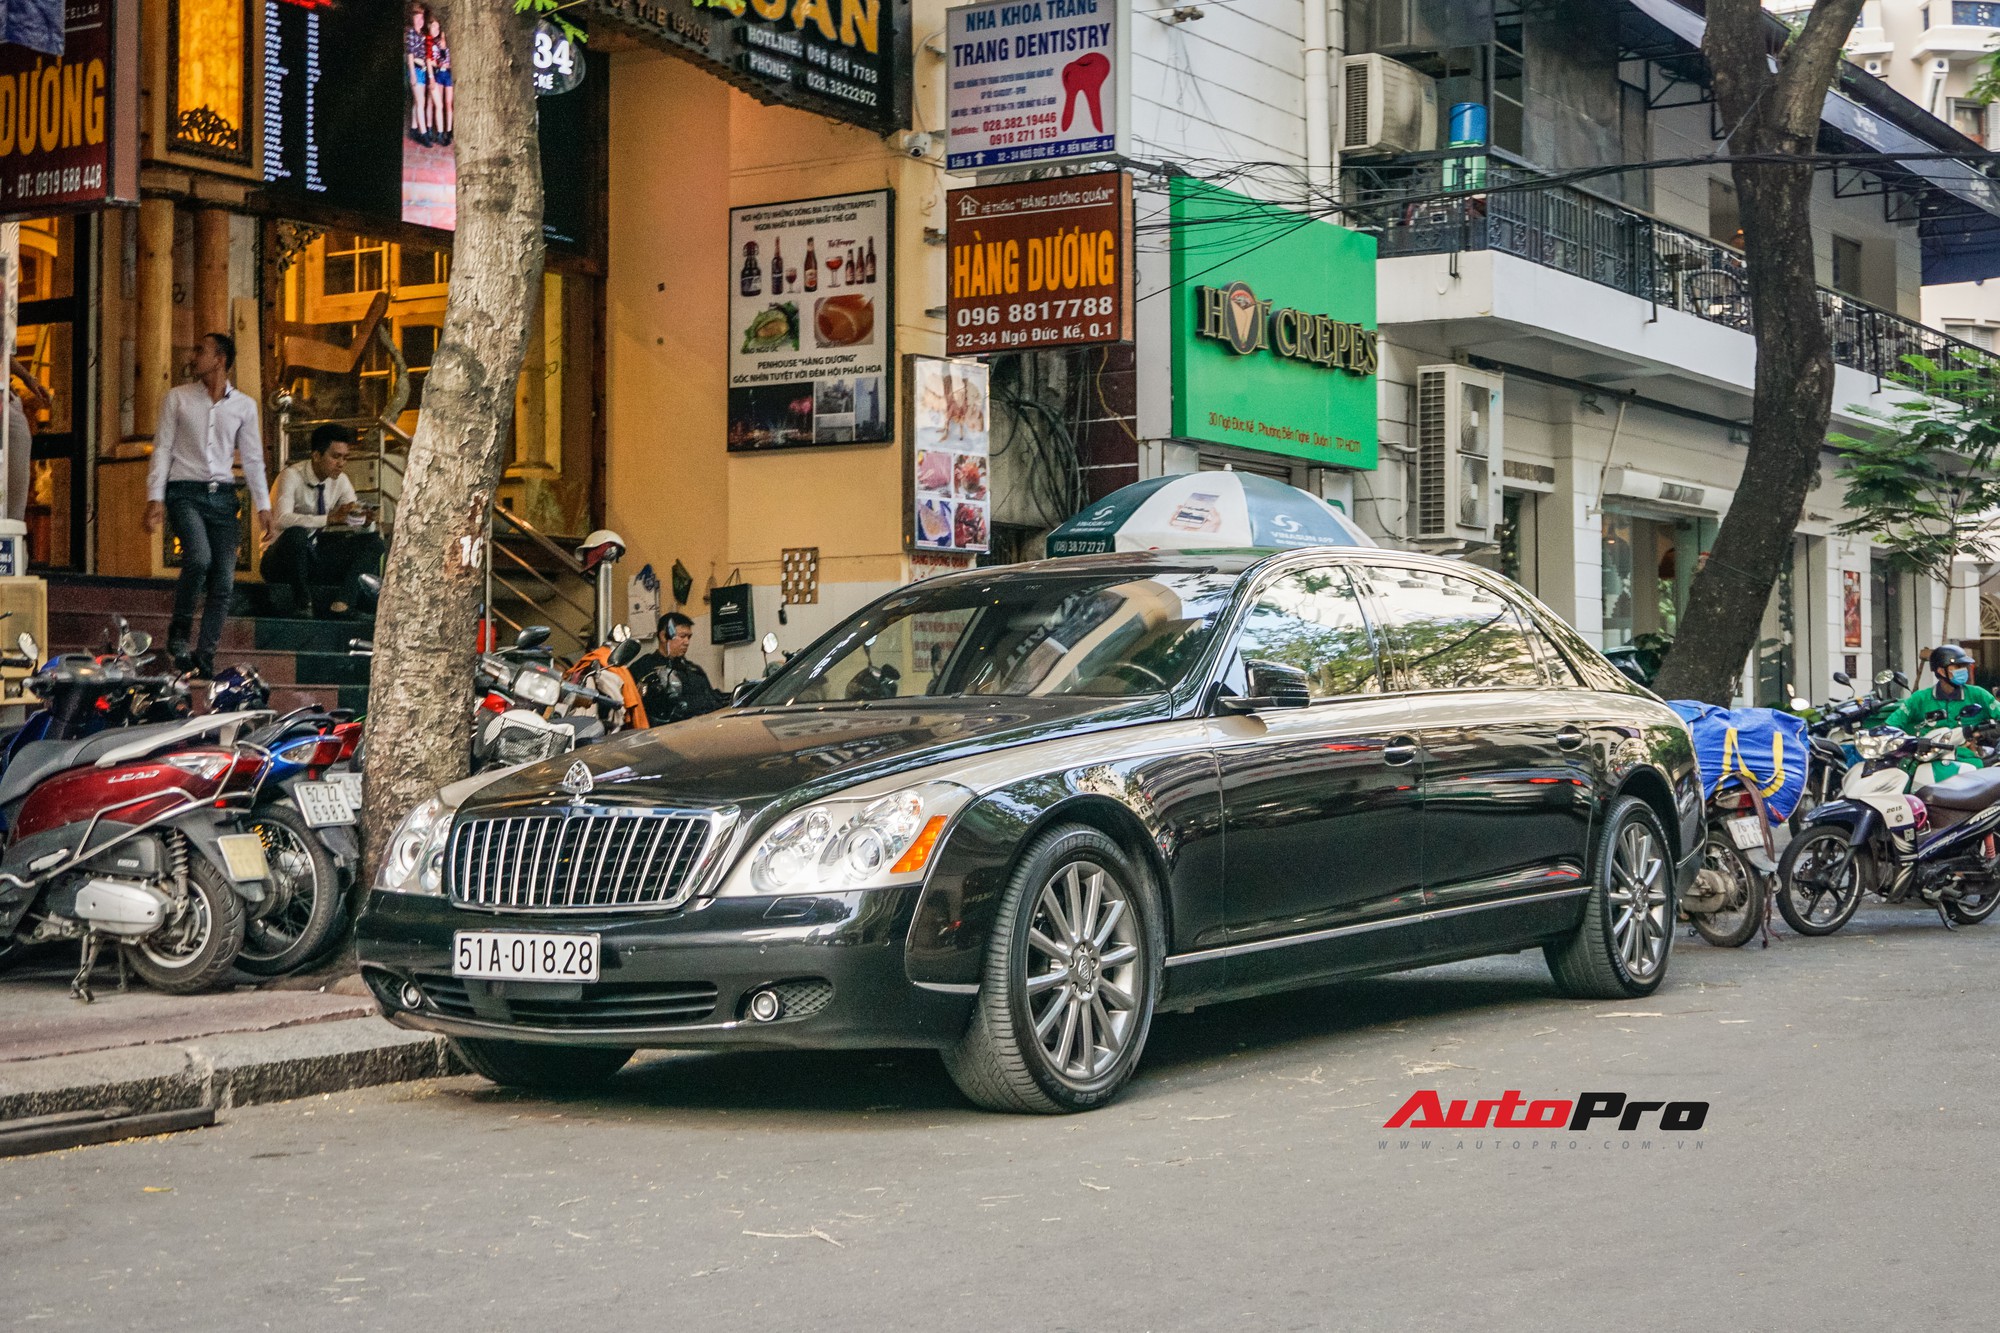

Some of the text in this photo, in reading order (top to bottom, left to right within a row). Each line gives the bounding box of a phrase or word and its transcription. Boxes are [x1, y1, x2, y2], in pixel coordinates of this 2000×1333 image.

[966, 0, 1097, 32] NHA KHOA TRANG
[533, 32, 574, 75] 34
[747, 24, 878, 84] HOTLINE: 096 881 7788
[953, 23, 1111, 67] TRANG DENTISTRY
[750, 51, 878, 107] PHONE: 028.38222972
[983, 112, 1057, 132] 028.382.19446
[990, 127, 1057, 145] 0918 271 153
[36, 169, 60, 196] 0919
[62, 167, 81, 193] 688
[83, 163, 102, 190] 448
[954, 230, 1019, 298] HÀNG
[957, 296, 1113, 327] 096 8817788
[956, 322, 1112, 347] 32-34 Ngô Đức Kế, Q.1
[107, 769, 160, 784] LEAD
[313, 803, 347, 821] 6983
[1886, 805, 1903, 814] 2015
[459, 938, 593, 975] 51A-018.28
